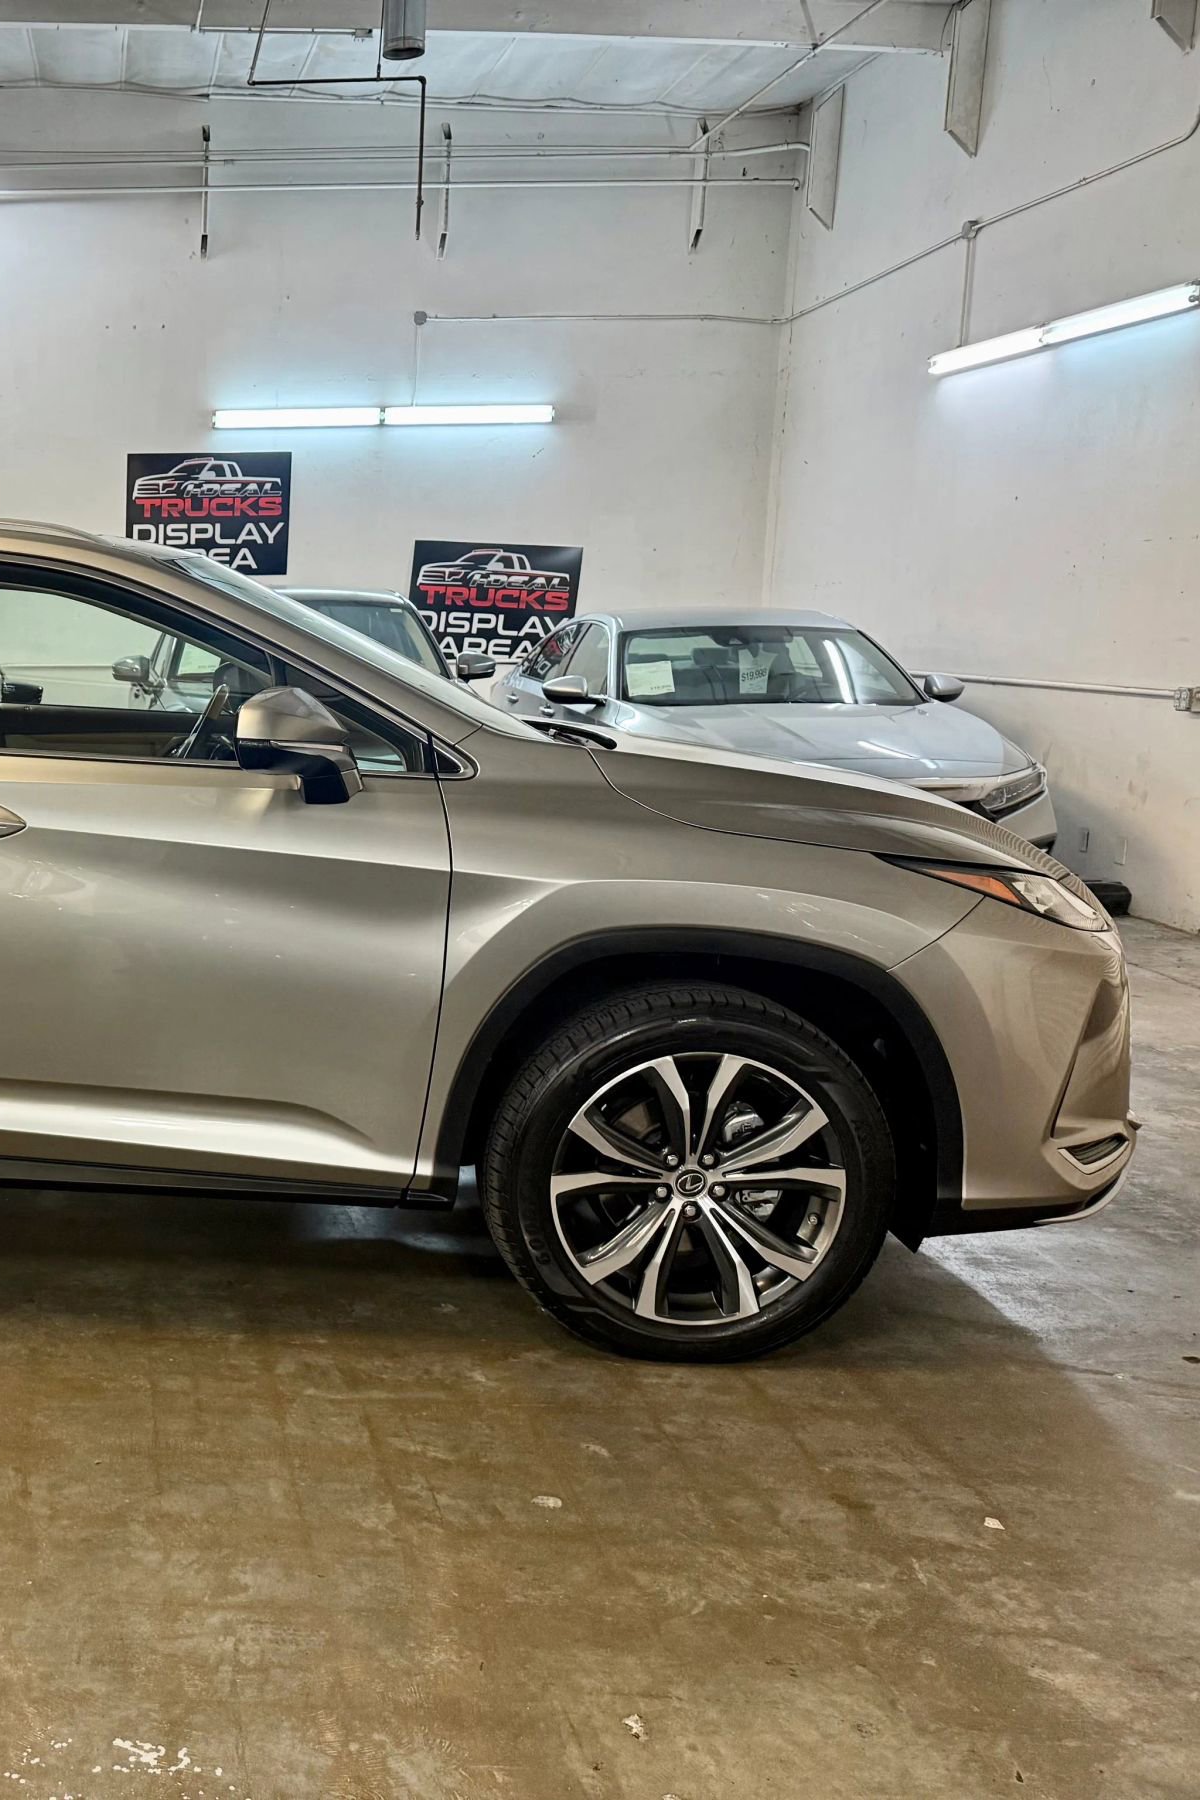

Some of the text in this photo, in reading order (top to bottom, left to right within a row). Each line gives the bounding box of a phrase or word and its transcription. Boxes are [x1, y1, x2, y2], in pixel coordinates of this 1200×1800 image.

[135, 497, 283, 518] TRUCKS
[132, 522, 285, 545] DISPLAY
[185, 548, 258, 569] EA
[418, 585, 570, 611] TRUCKS
